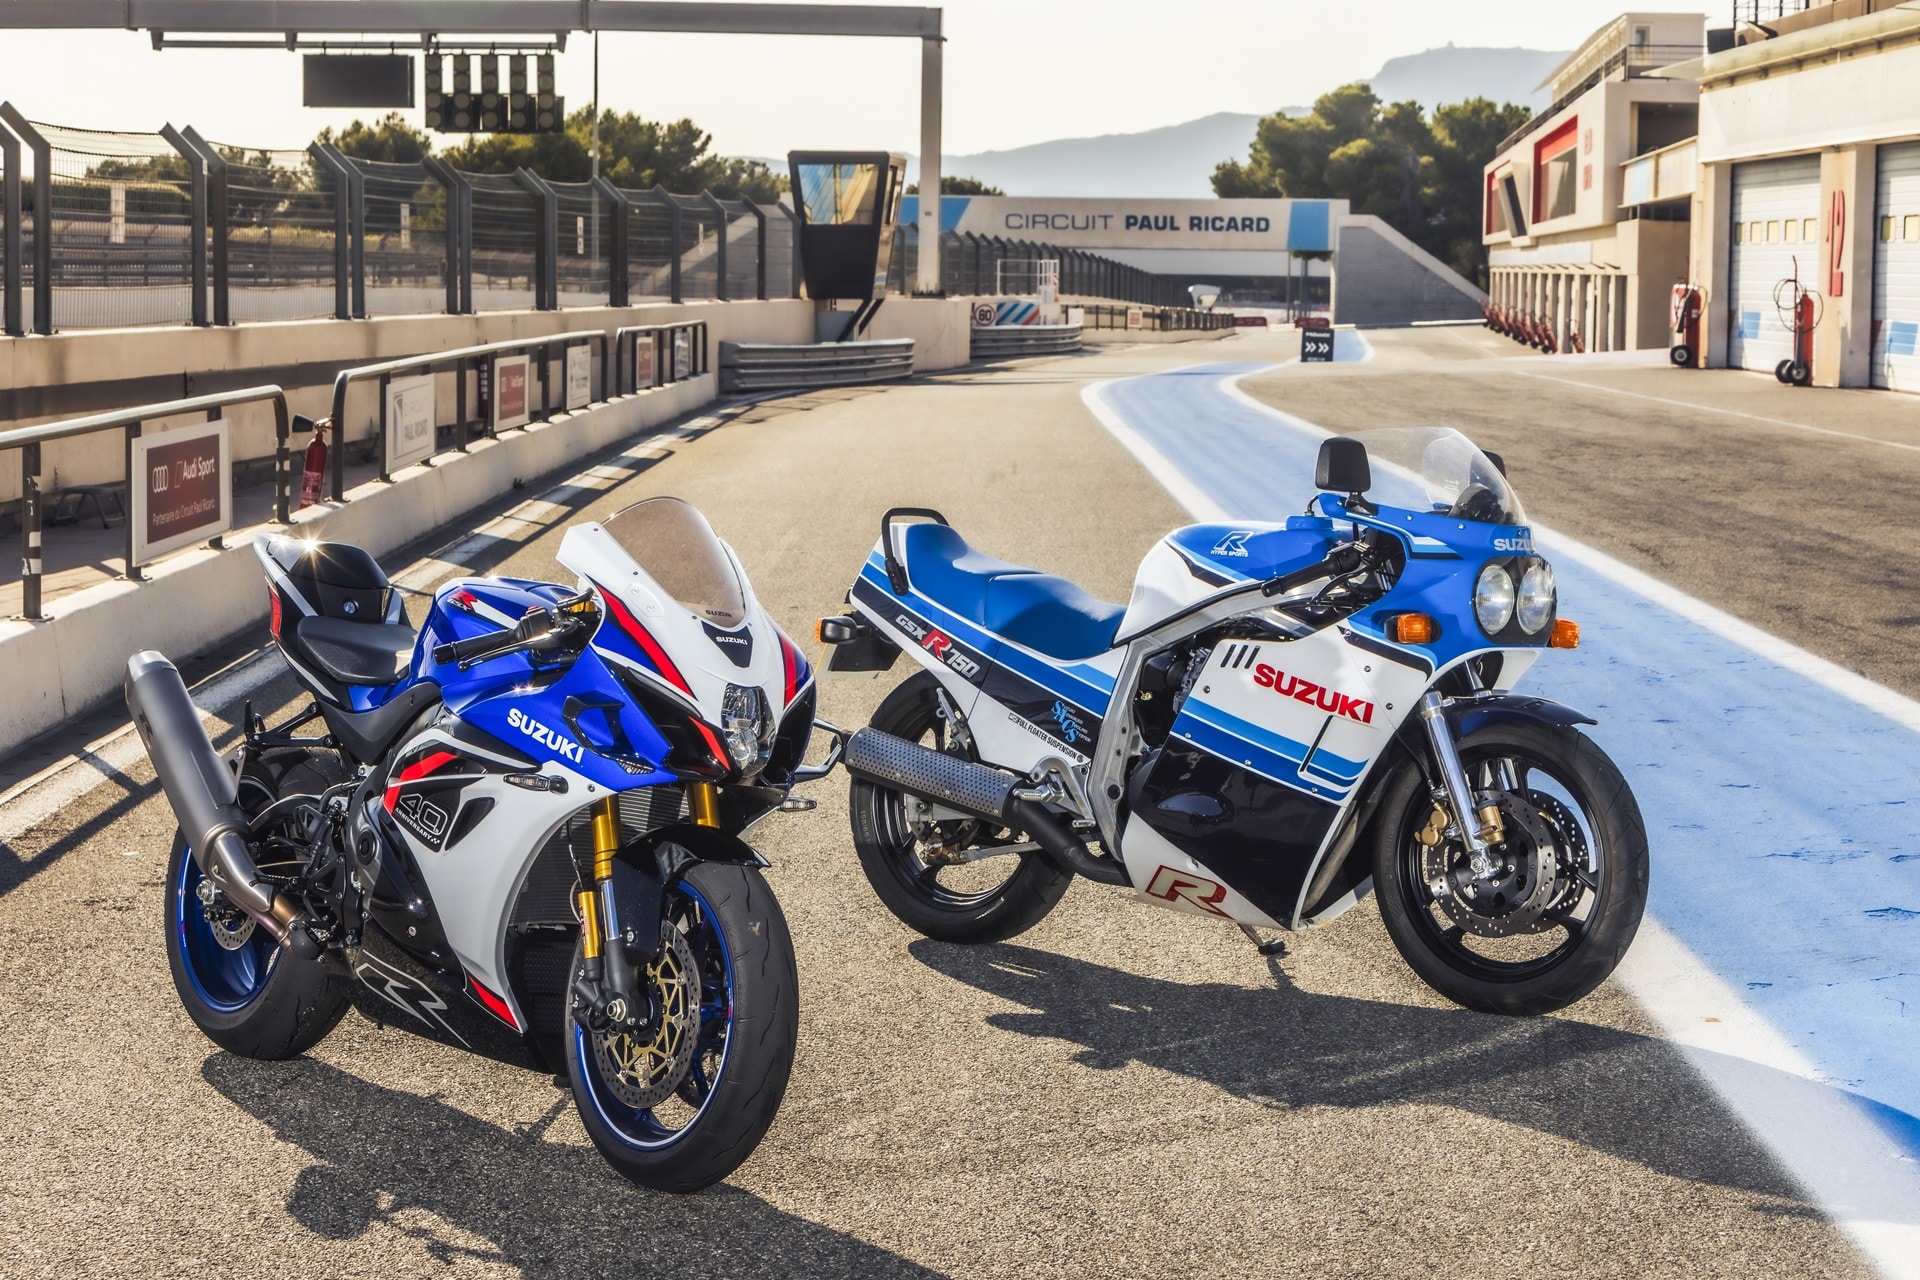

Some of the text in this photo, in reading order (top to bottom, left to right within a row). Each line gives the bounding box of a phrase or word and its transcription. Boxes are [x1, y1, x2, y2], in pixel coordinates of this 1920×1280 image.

[1004, 213, 1270, 233] CIRCUIT PAUL RICARD
[1826, 190, 1845, 297] 12
[978, 308, 992, 322] 60
[183, 456, 215, 481] Audi Sport
[153, 510, 175, 527] Partenaire
[1213, 531, 1254, 552] R
[715, 636, 748, 646] SUZUKI
[1252, 663, 1375, 724] SUZUKI
[507, 707, 584, 764] SUZUKI
[1017, 718, 1028, 730] FULL
[1027, 724, 1048, 742] FLOATER
[1046, 737, 1077, 760] SUSPENSION
[395, 807, 432, 840] ANNIVERSARY
[1144, 864, 1236, 921] R
